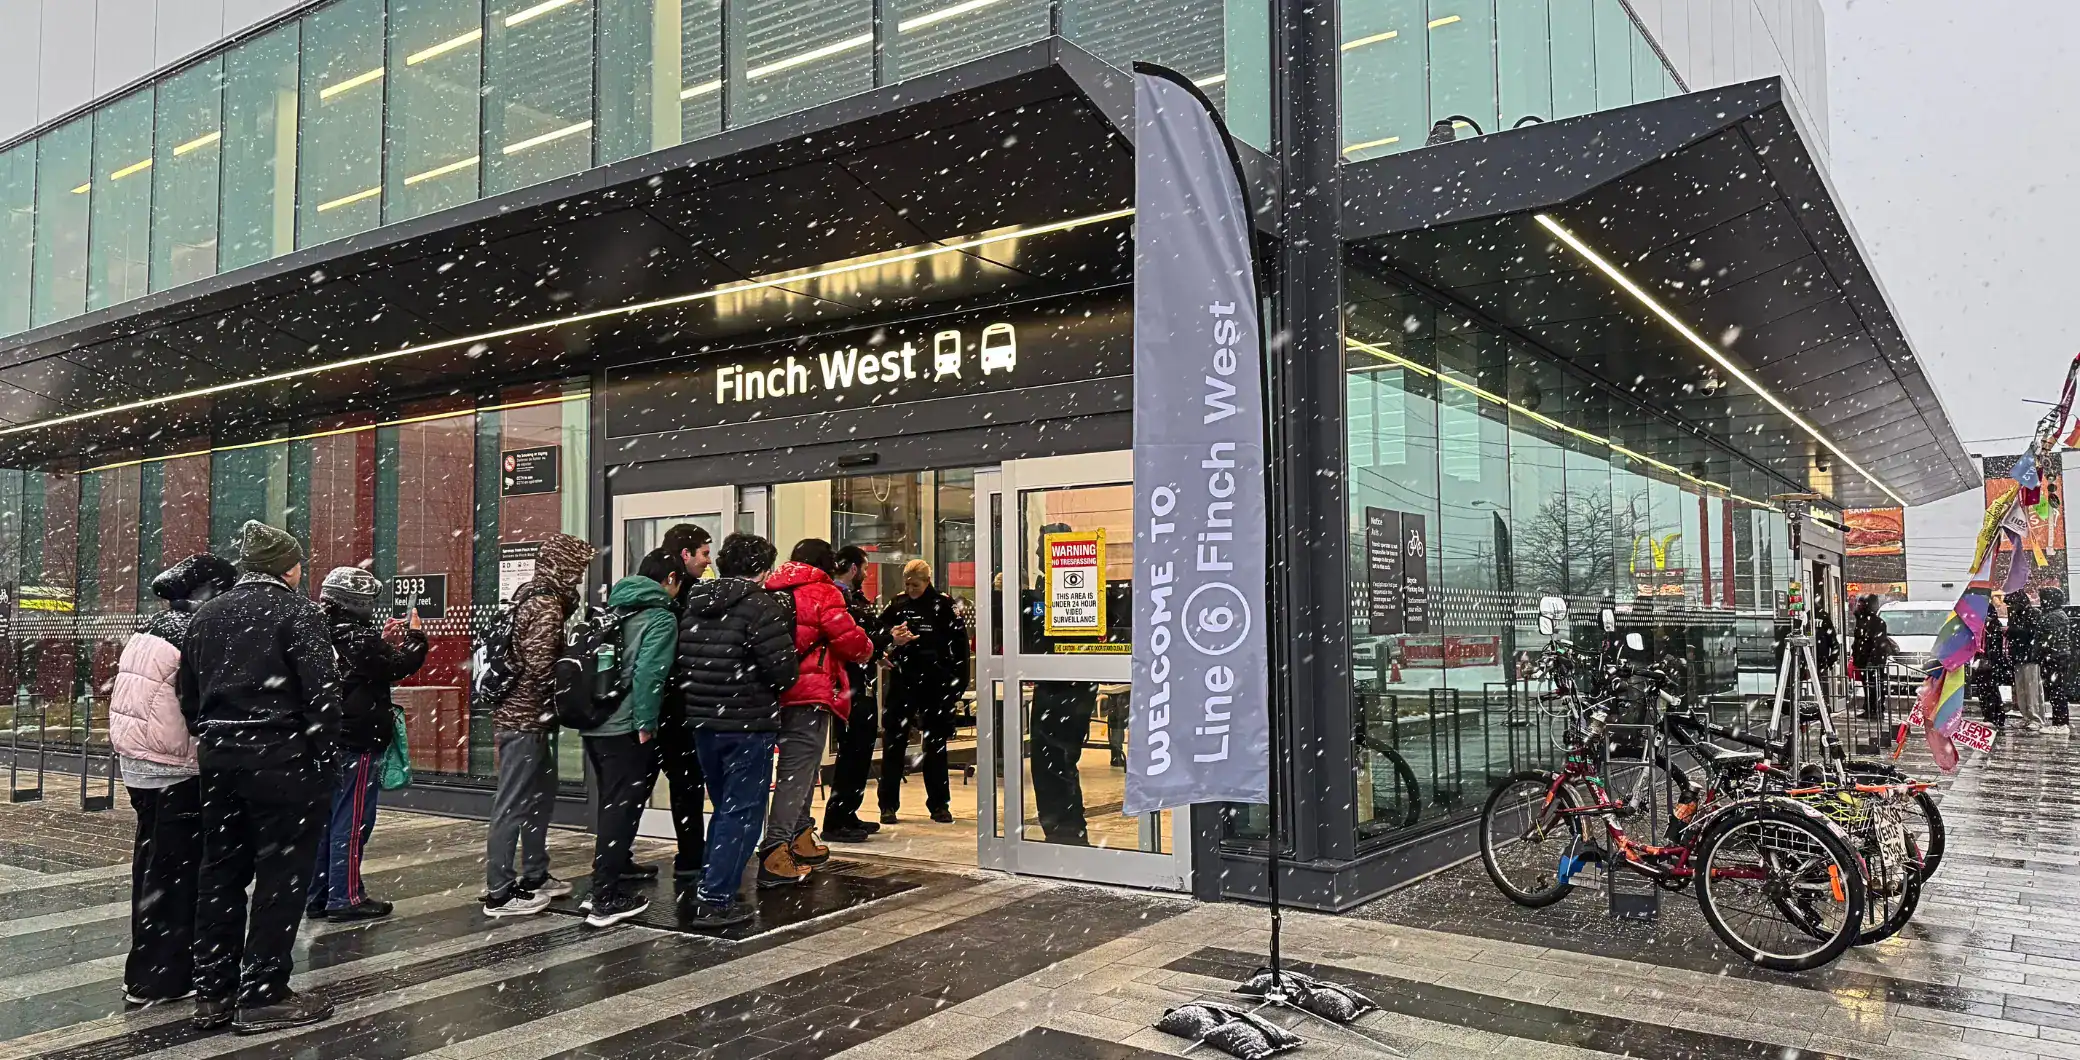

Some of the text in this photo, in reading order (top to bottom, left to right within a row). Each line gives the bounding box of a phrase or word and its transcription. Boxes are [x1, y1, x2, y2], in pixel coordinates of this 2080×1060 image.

[716, 341, 917, 404] Finch West
[1193, 300, 1237, 762] Line 6 Finch West
[1052, 543, 1096, 557] WARNING
[1060, 557, 1096, 566] TRESPASSING
[394, 578, 425, 595] 3933
[394, 597, 409, 606] Keel
[1070, 592, 1086, 600] AREA
[1087, 592, 1094, 600] IS
[1051, 600, 1097, 608] UNDER 24 HOUR
[1065, 608, 1083, 616] VIDEO
[1053, 615, 1096, 624] SURVEILLANCE
[1147, 486, 1176, 776] WELCOME TO
[1960, 720, 1992, 739] TEAD
